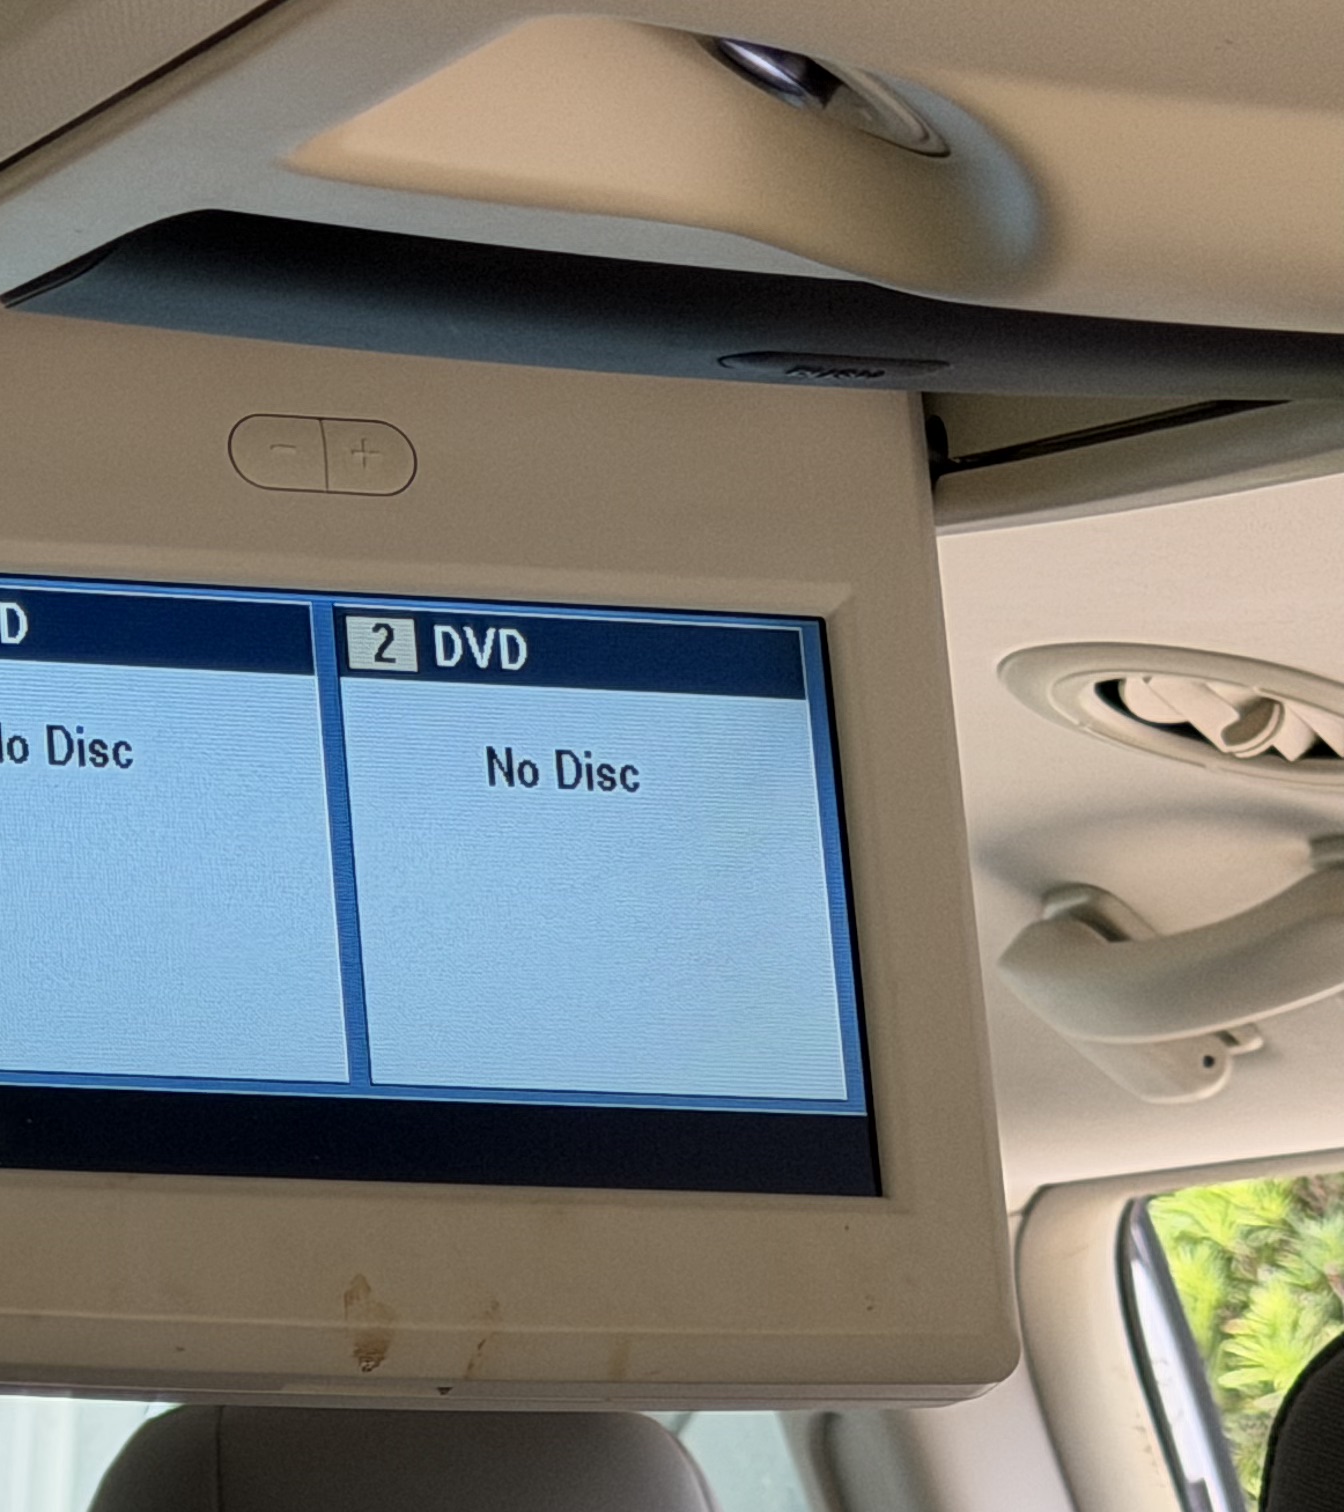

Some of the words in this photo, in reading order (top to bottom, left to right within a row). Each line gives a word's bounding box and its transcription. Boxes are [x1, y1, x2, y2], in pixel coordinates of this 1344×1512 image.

[372, 622, 397, 664] 2
[433, 624, 529, 671] DVD
[45, 723, 134, 769] Disc
[485, 745, 540, 789] No
[555, 748, 641, 793] Disc
